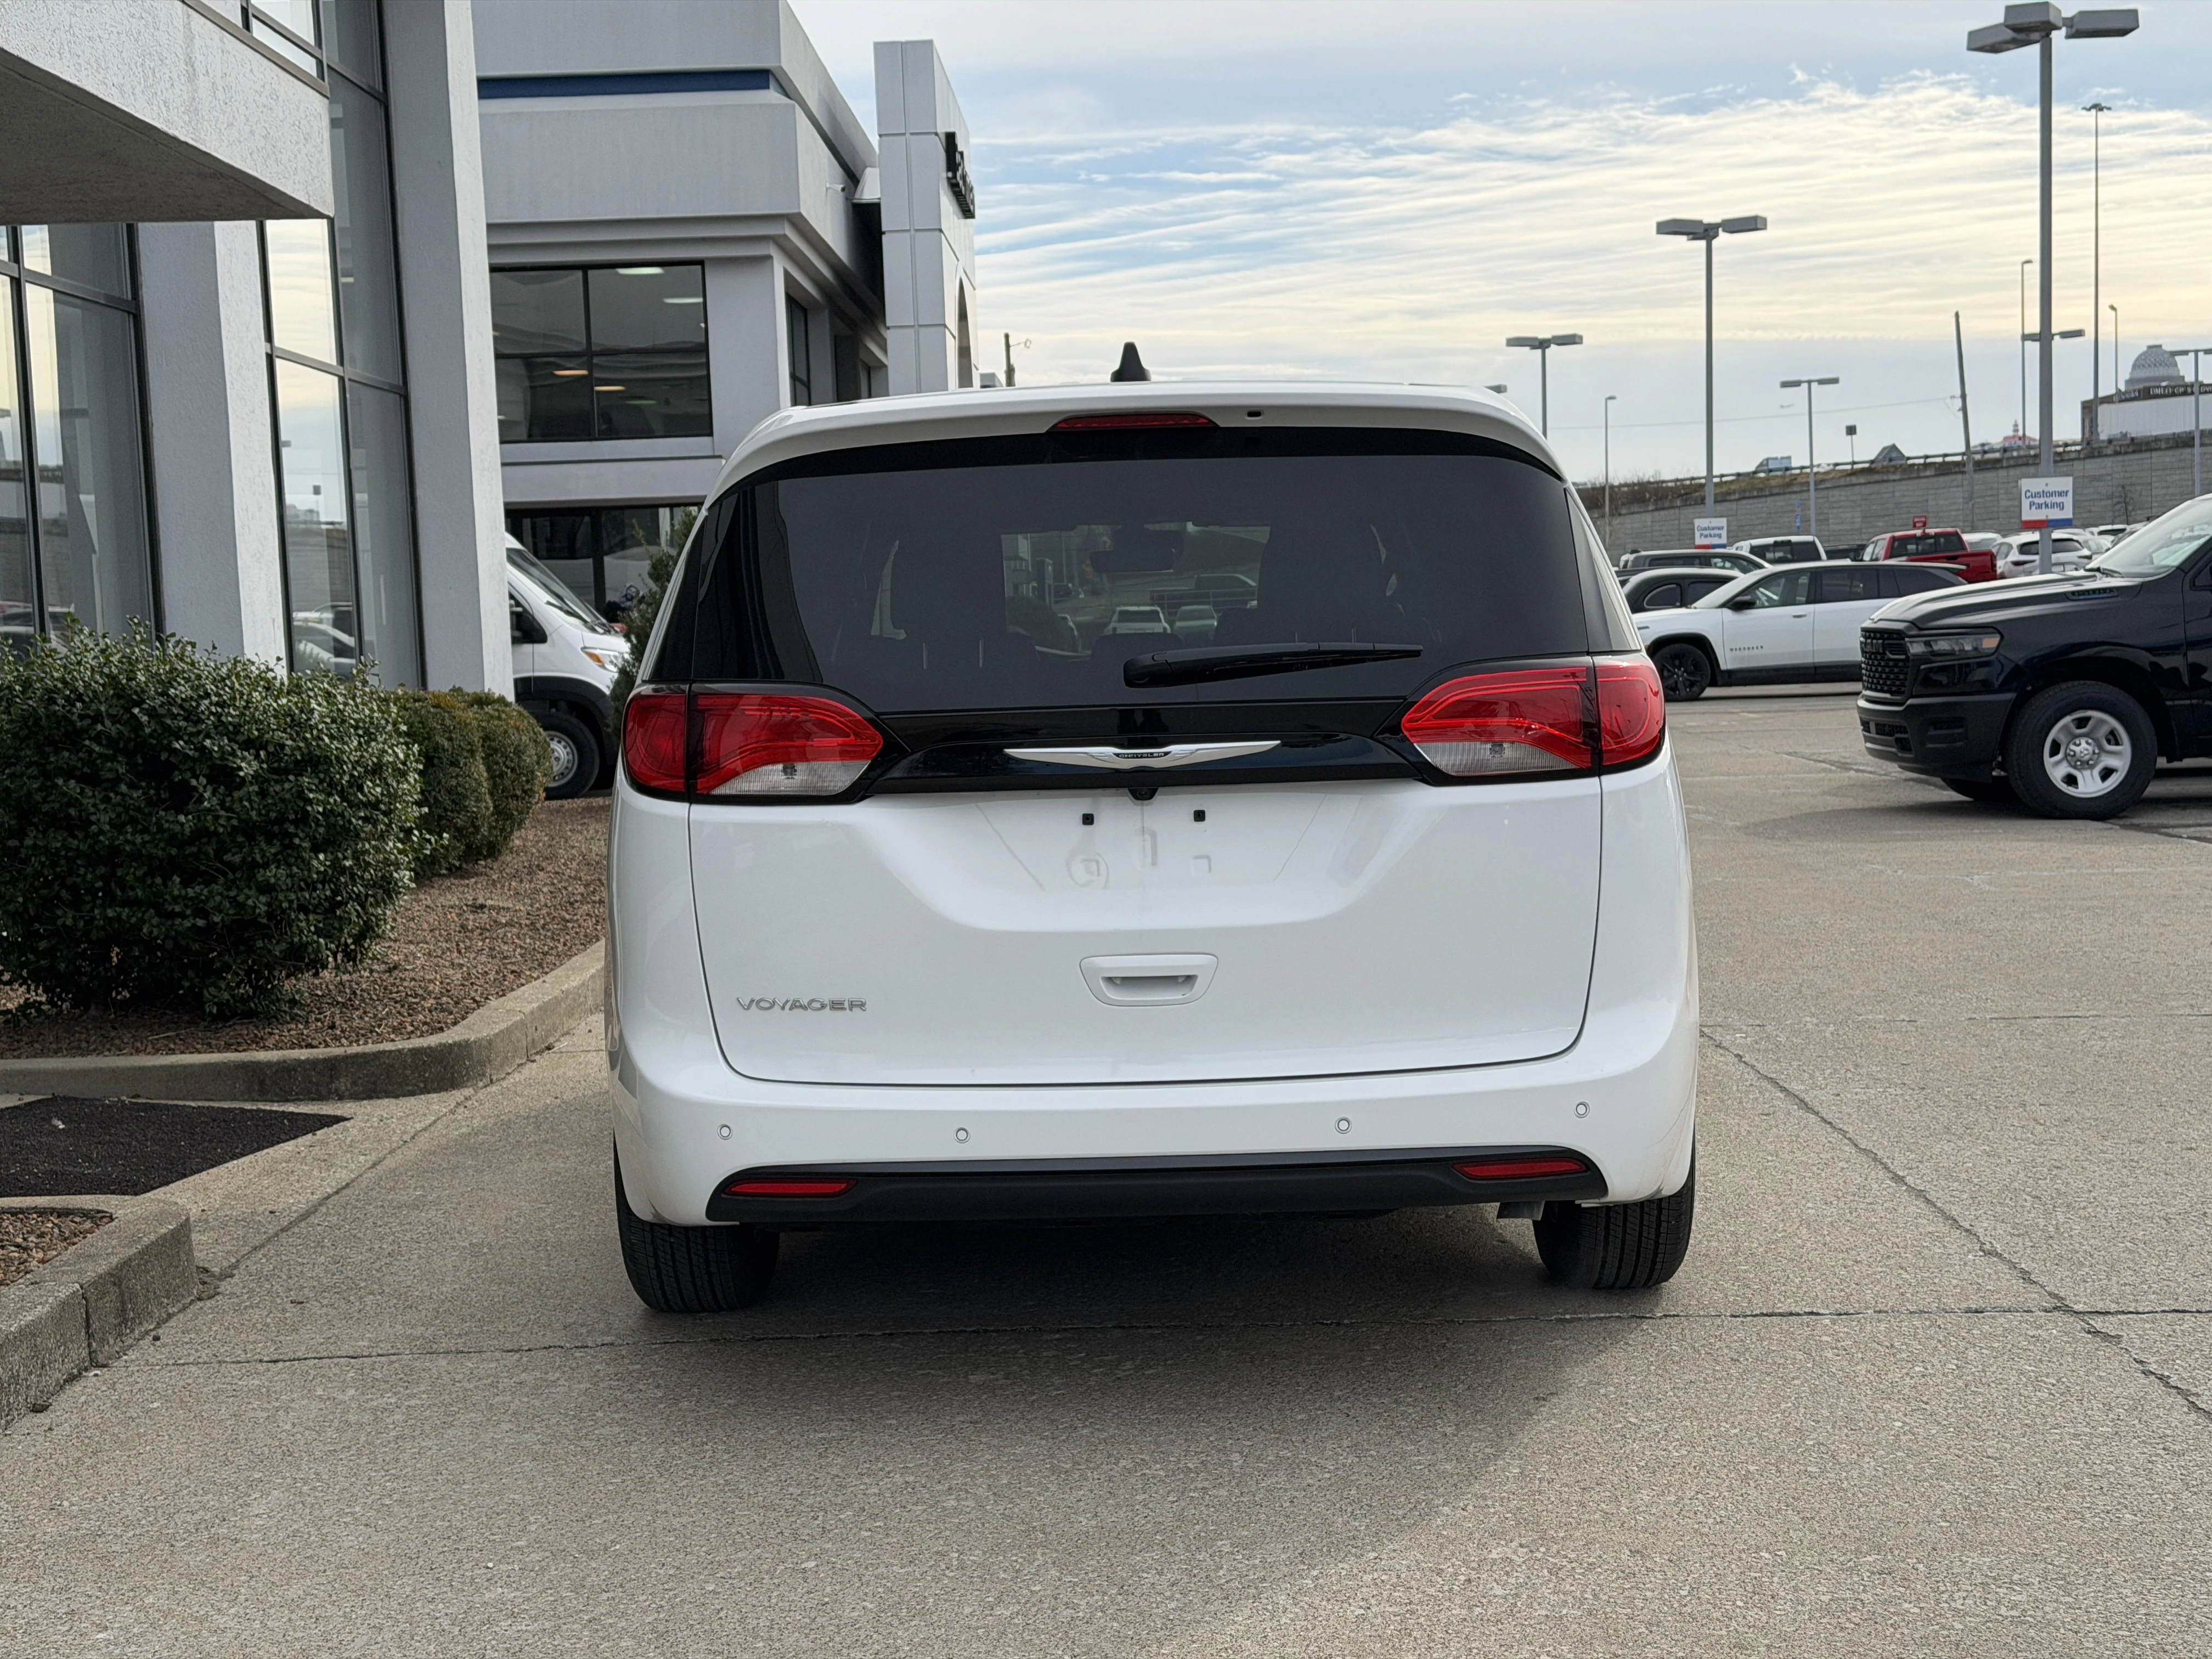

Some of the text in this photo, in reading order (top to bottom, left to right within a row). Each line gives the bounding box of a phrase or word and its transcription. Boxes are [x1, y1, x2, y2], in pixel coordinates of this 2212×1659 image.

[2024, 489, 2069, 499] Customer
[2029, 500, 2064, 511] Parking
[736, 997, 867, 1012] VOYAGER
